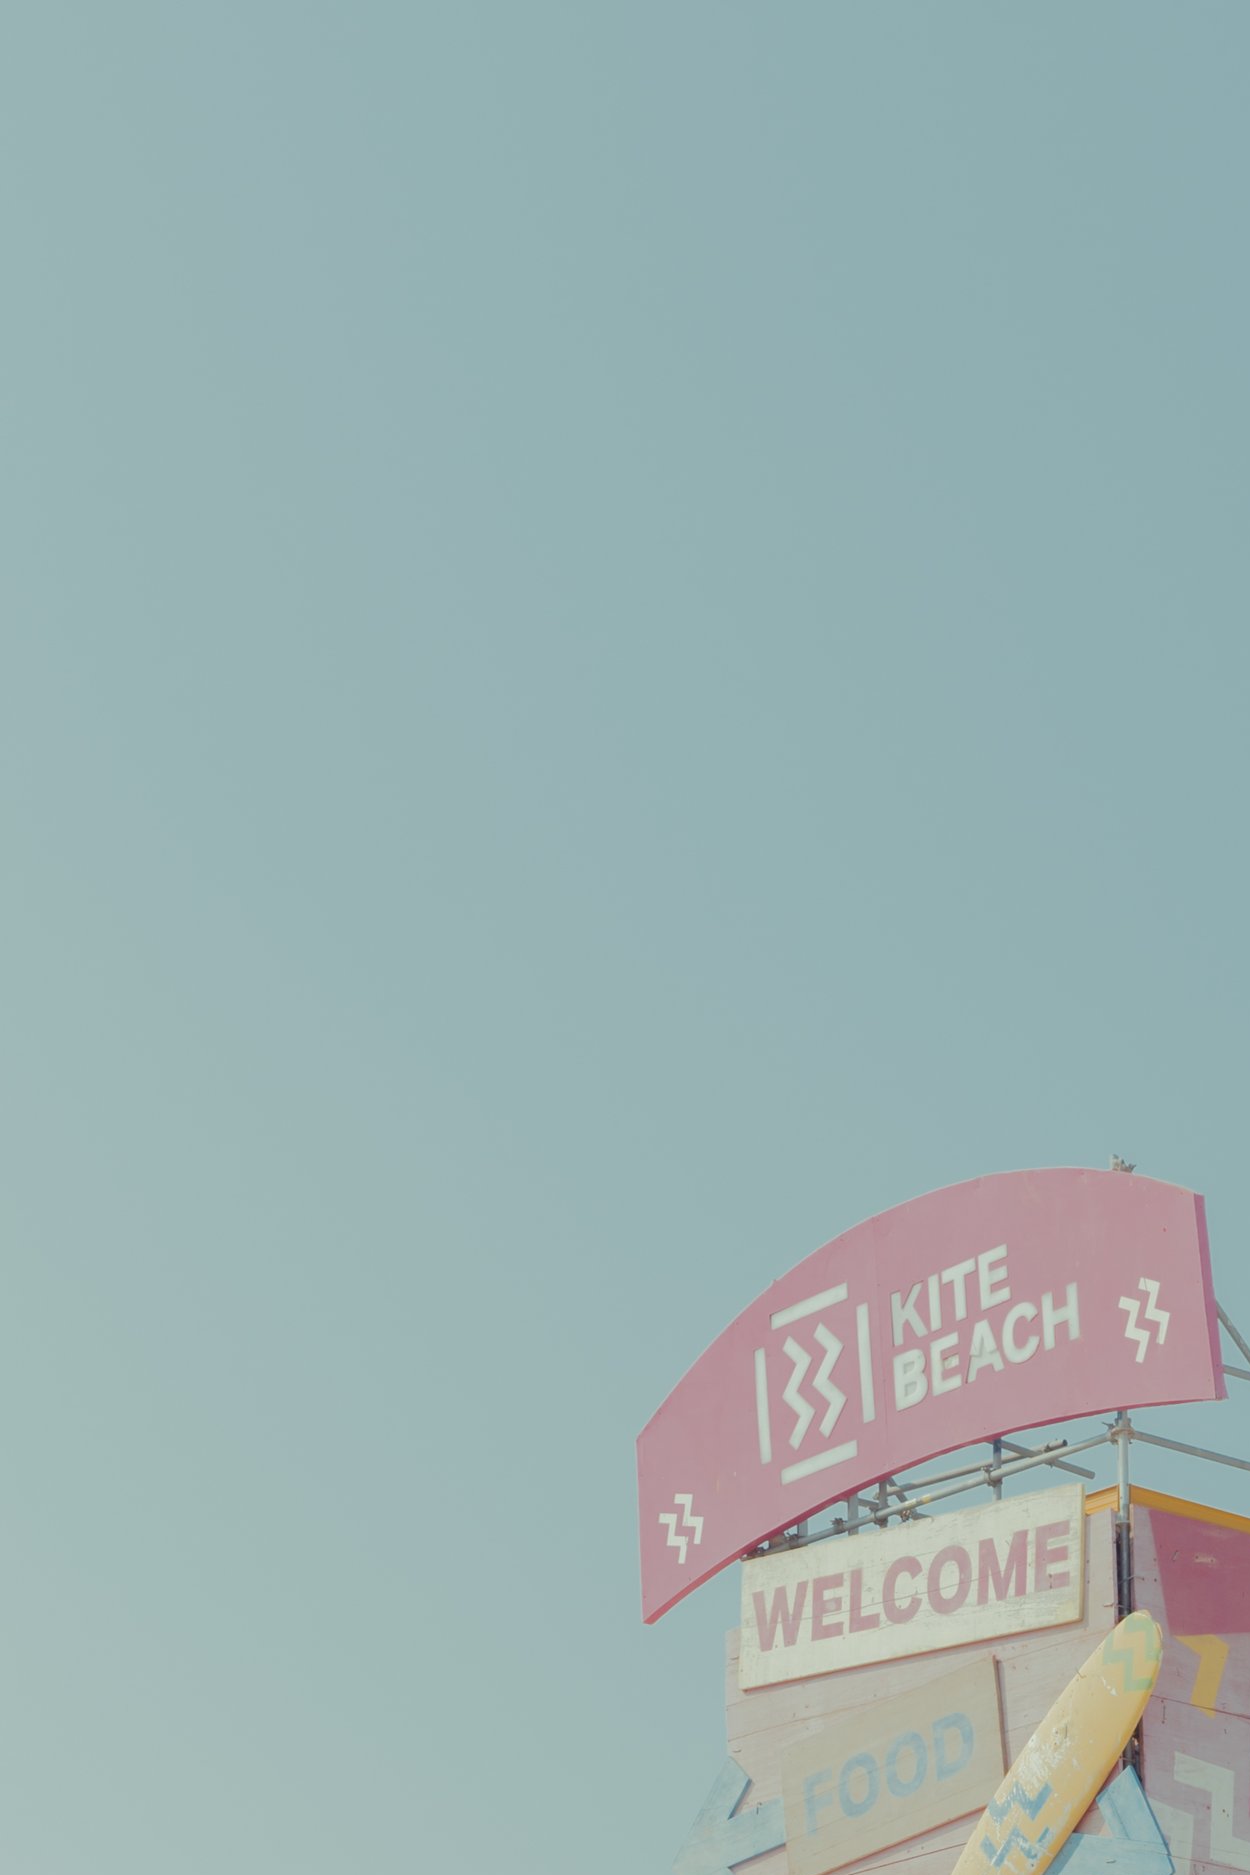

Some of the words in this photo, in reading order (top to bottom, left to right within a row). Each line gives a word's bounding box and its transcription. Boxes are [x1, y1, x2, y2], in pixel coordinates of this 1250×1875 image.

[890, 1243, 1011, 1347] KITE
[892, 1281, 1081, 1412] BEACH
[752, 1519, 1070, 1652] WELCOME
[802, 1711, 974, 1836] FOOD
